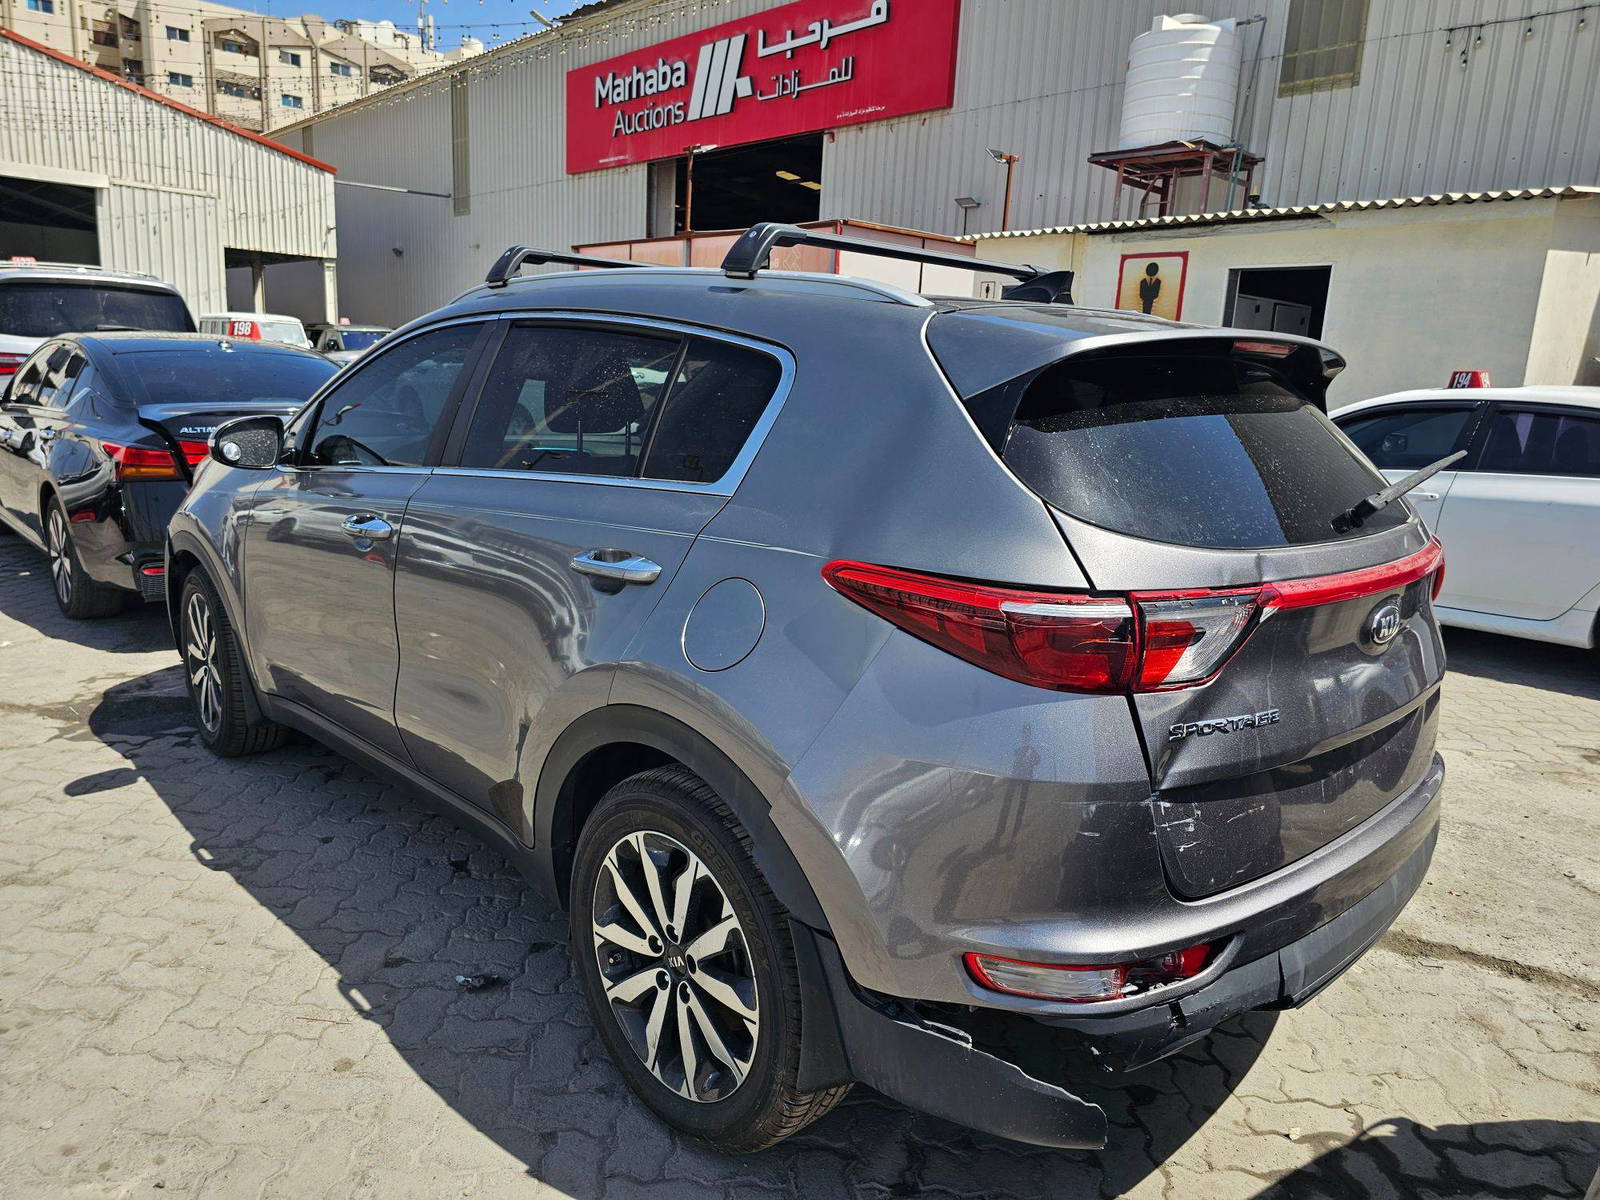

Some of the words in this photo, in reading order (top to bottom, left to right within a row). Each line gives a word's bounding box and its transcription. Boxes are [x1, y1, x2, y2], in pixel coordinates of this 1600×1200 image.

[757, 0, 888, 59] مرحبا
[595, 57, 687, 109] Marhaba
[757, 55, 854, 101] للمزادات
[613, 101, 686, 138] Auctions
[233, 321, 252, 335] 198
[1452, 371, 1473, 388] 194
[179, 426, 216, 434] ALTIM
[1168, 708, 1280, 742] SPORTAGE
[667, 956, 685, 968] KIA
